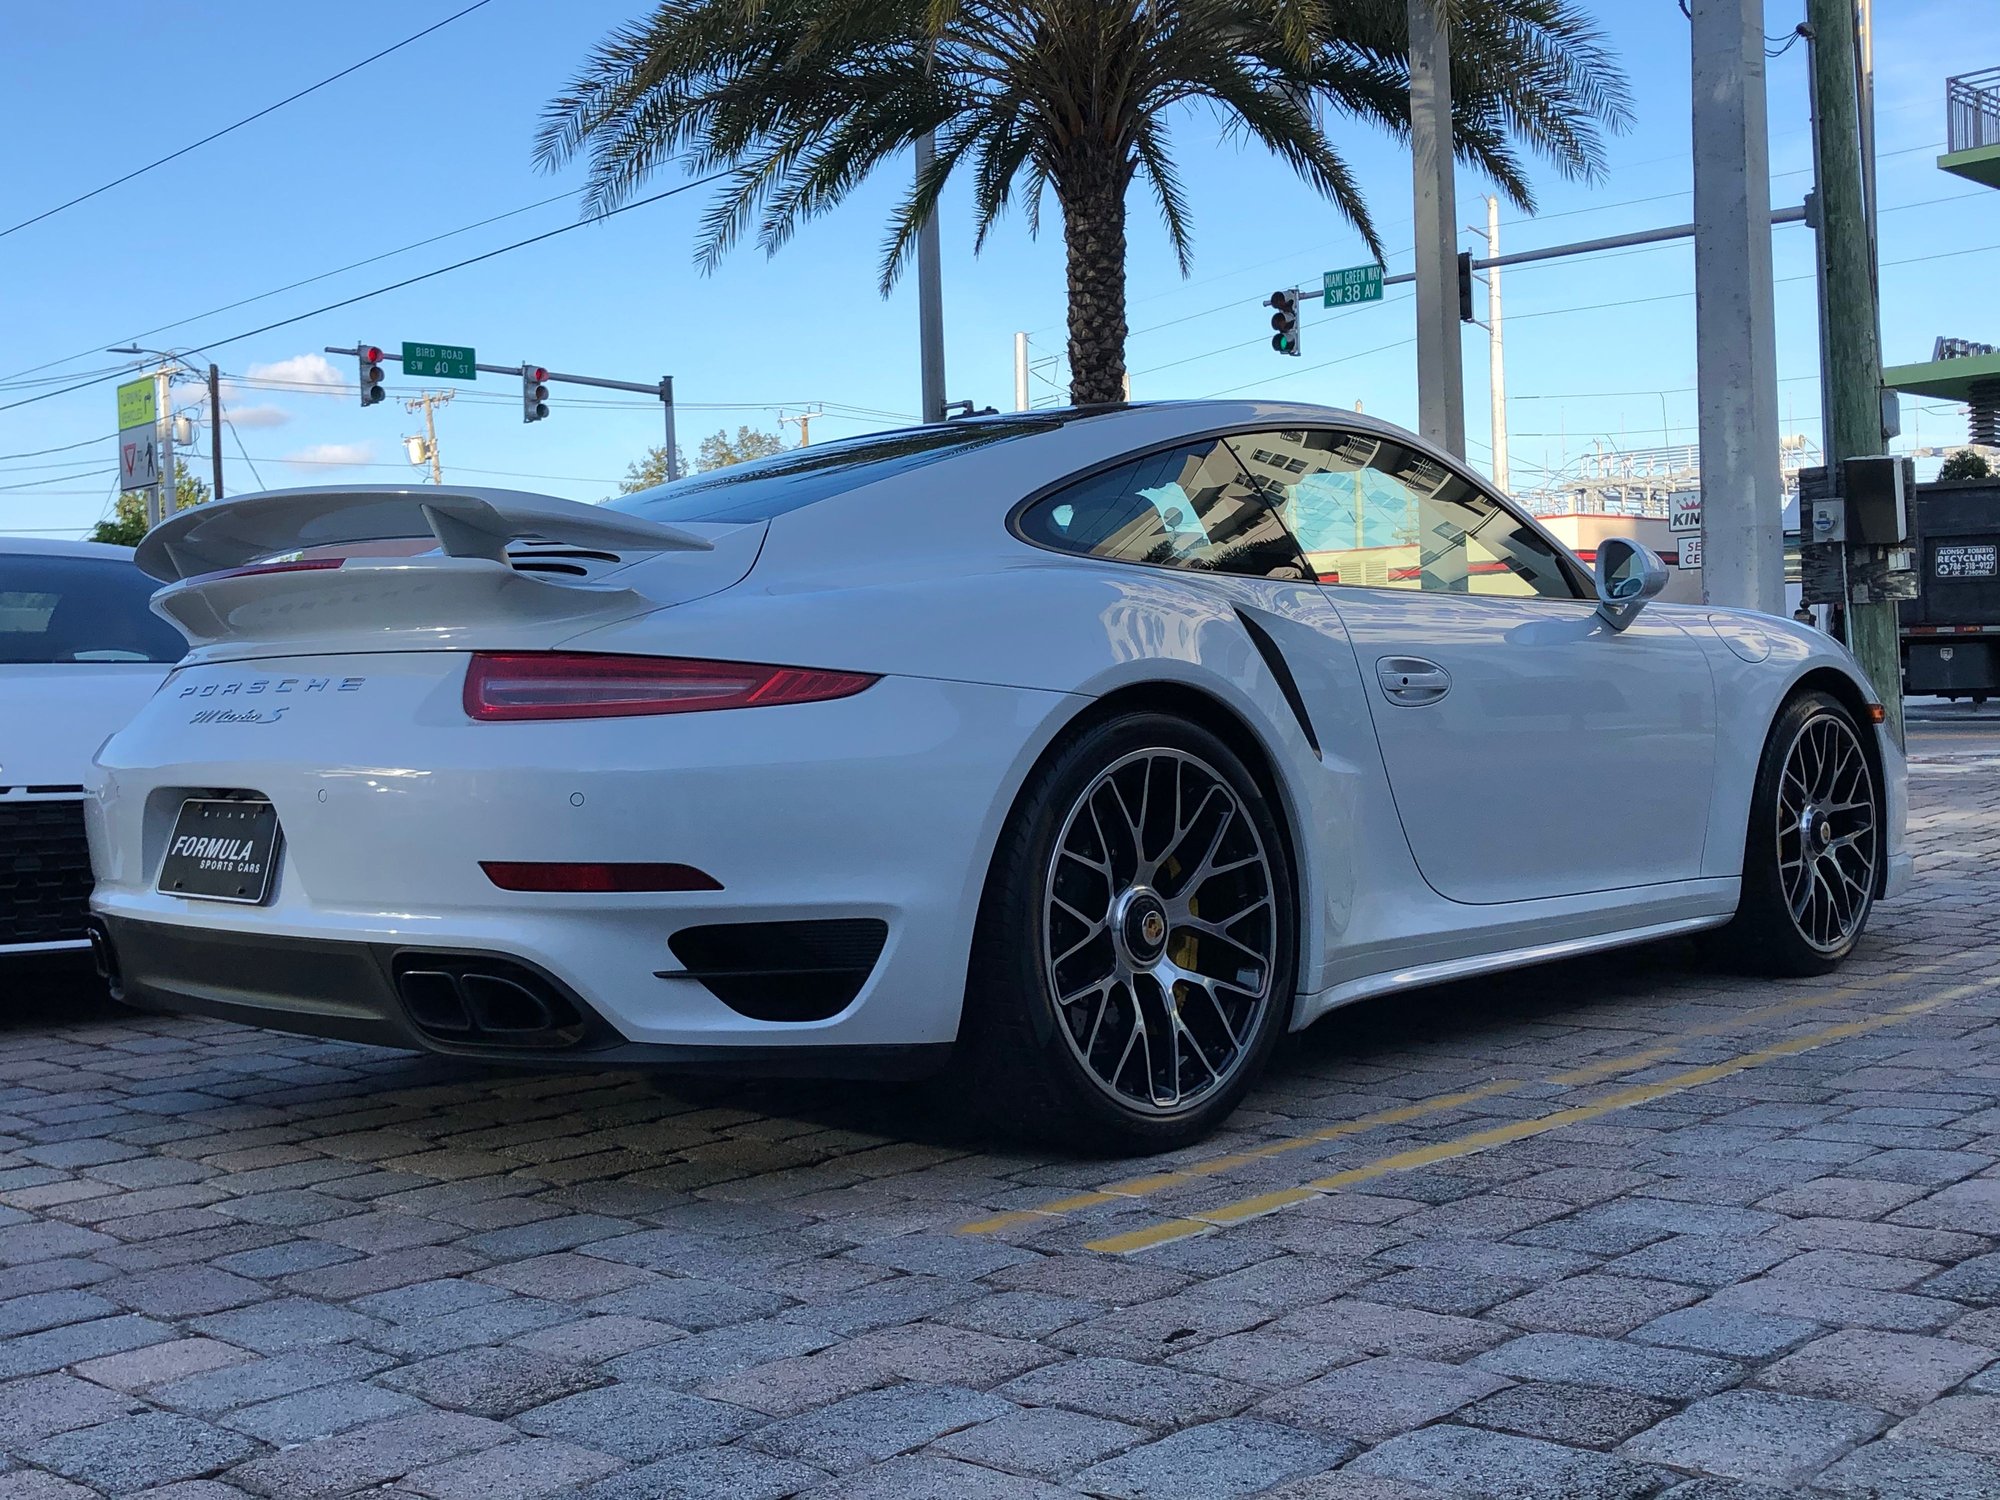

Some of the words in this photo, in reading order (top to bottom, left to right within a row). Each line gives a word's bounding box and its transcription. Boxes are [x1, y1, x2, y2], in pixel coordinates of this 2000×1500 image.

[1325, 273, 1342, 288] MIAMI
[1344, 268, 1365, 285] GREEN
[1367, 265, 1381, 281] WAY
[1330, 288, 1343, 304] SW
[1344, 284, 1360, 303] 38
[1364, 283, 1375, 298] AV
[415, 346, 436, 358] BIRD
[441, 349, 464, 360] ROAD
[410, 360, 423, 371] SW
[434, 361, 449, 374] 40
[458, 364, 469, 374] ST
[1672, 512, 1701, 526] KIN
[1937, 554, 1995, 563] RECYCLING
[178, 677, 366, 699] PORSCHE
[171, 835, 254, 861] FORMULA
[199, 859, 234, 872] SPORTS
[237, 862, 260, 874] CARS
